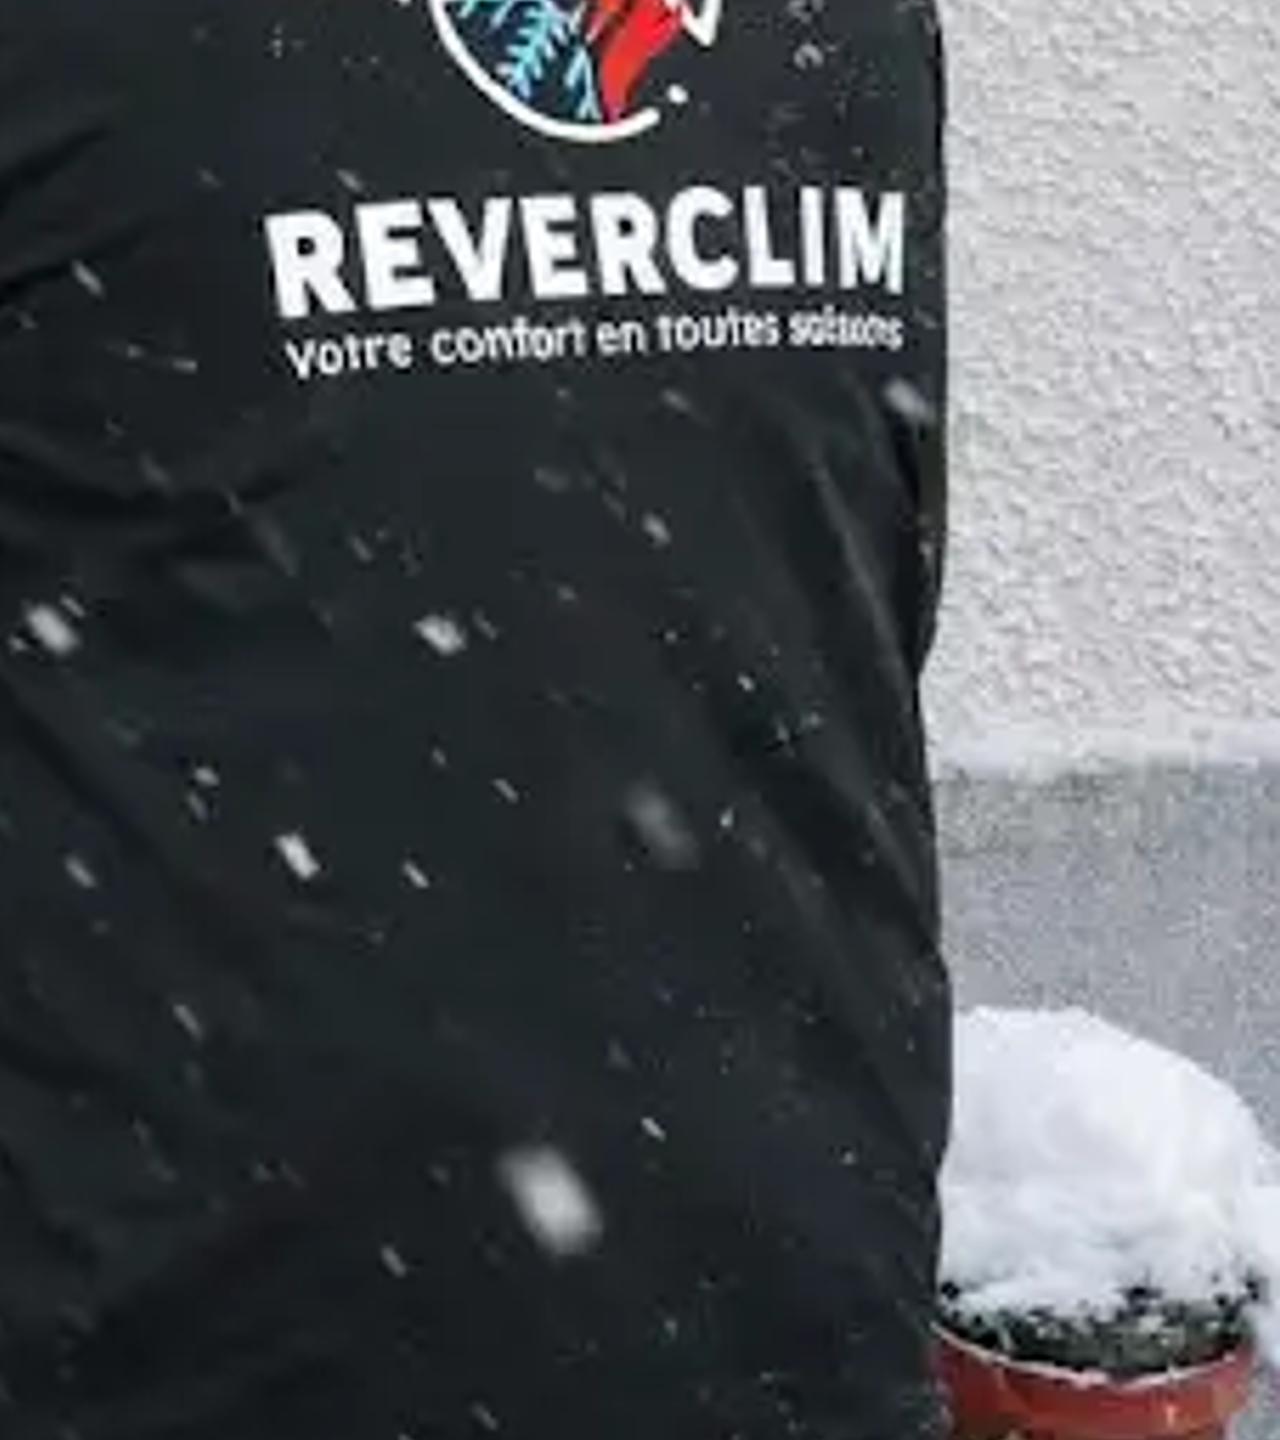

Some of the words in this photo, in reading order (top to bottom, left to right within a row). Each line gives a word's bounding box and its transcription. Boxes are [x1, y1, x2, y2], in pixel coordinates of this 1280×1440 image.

[264, 185, 905, 319] REVERCLIM
[429, 315, 588, 364] confort
[596, 321, 647, 357] en
[655, 305, 781, 352] toutes
